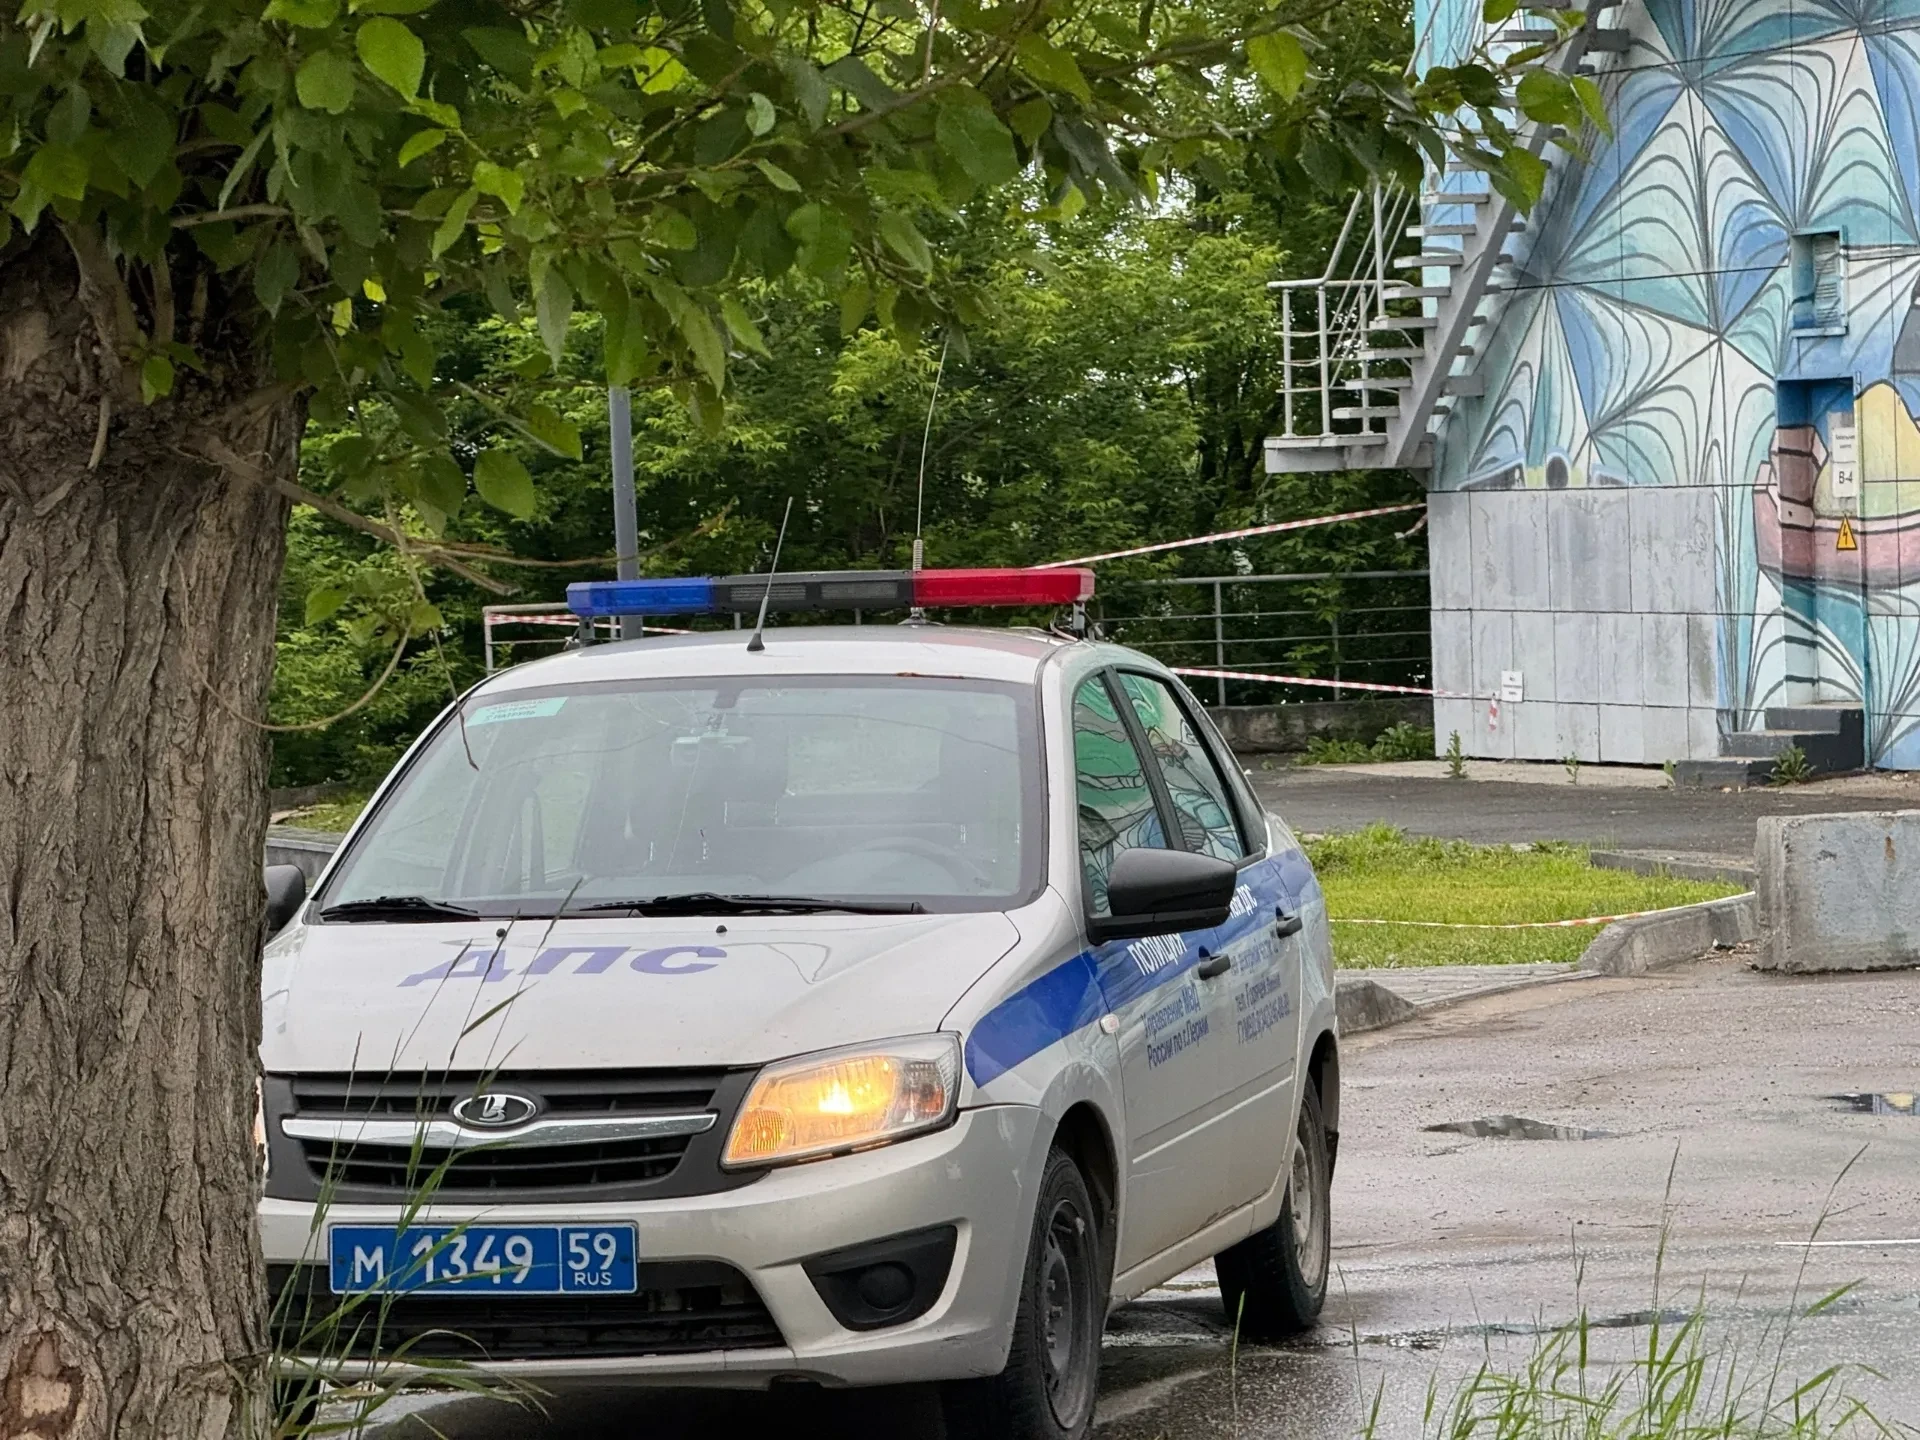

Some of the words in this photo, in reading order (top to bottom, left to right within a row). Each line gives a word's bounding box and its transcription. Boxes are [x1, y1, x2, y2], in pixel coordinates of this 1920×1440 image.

[396, 945, 728, 987] ДПС
[1181, 980, 1201, 1014] МВД
[411, 1235, 534, 1285] 1349
[567, 1233, 617, 1271] 59
[574, 1272, 613, 1287] RUS
